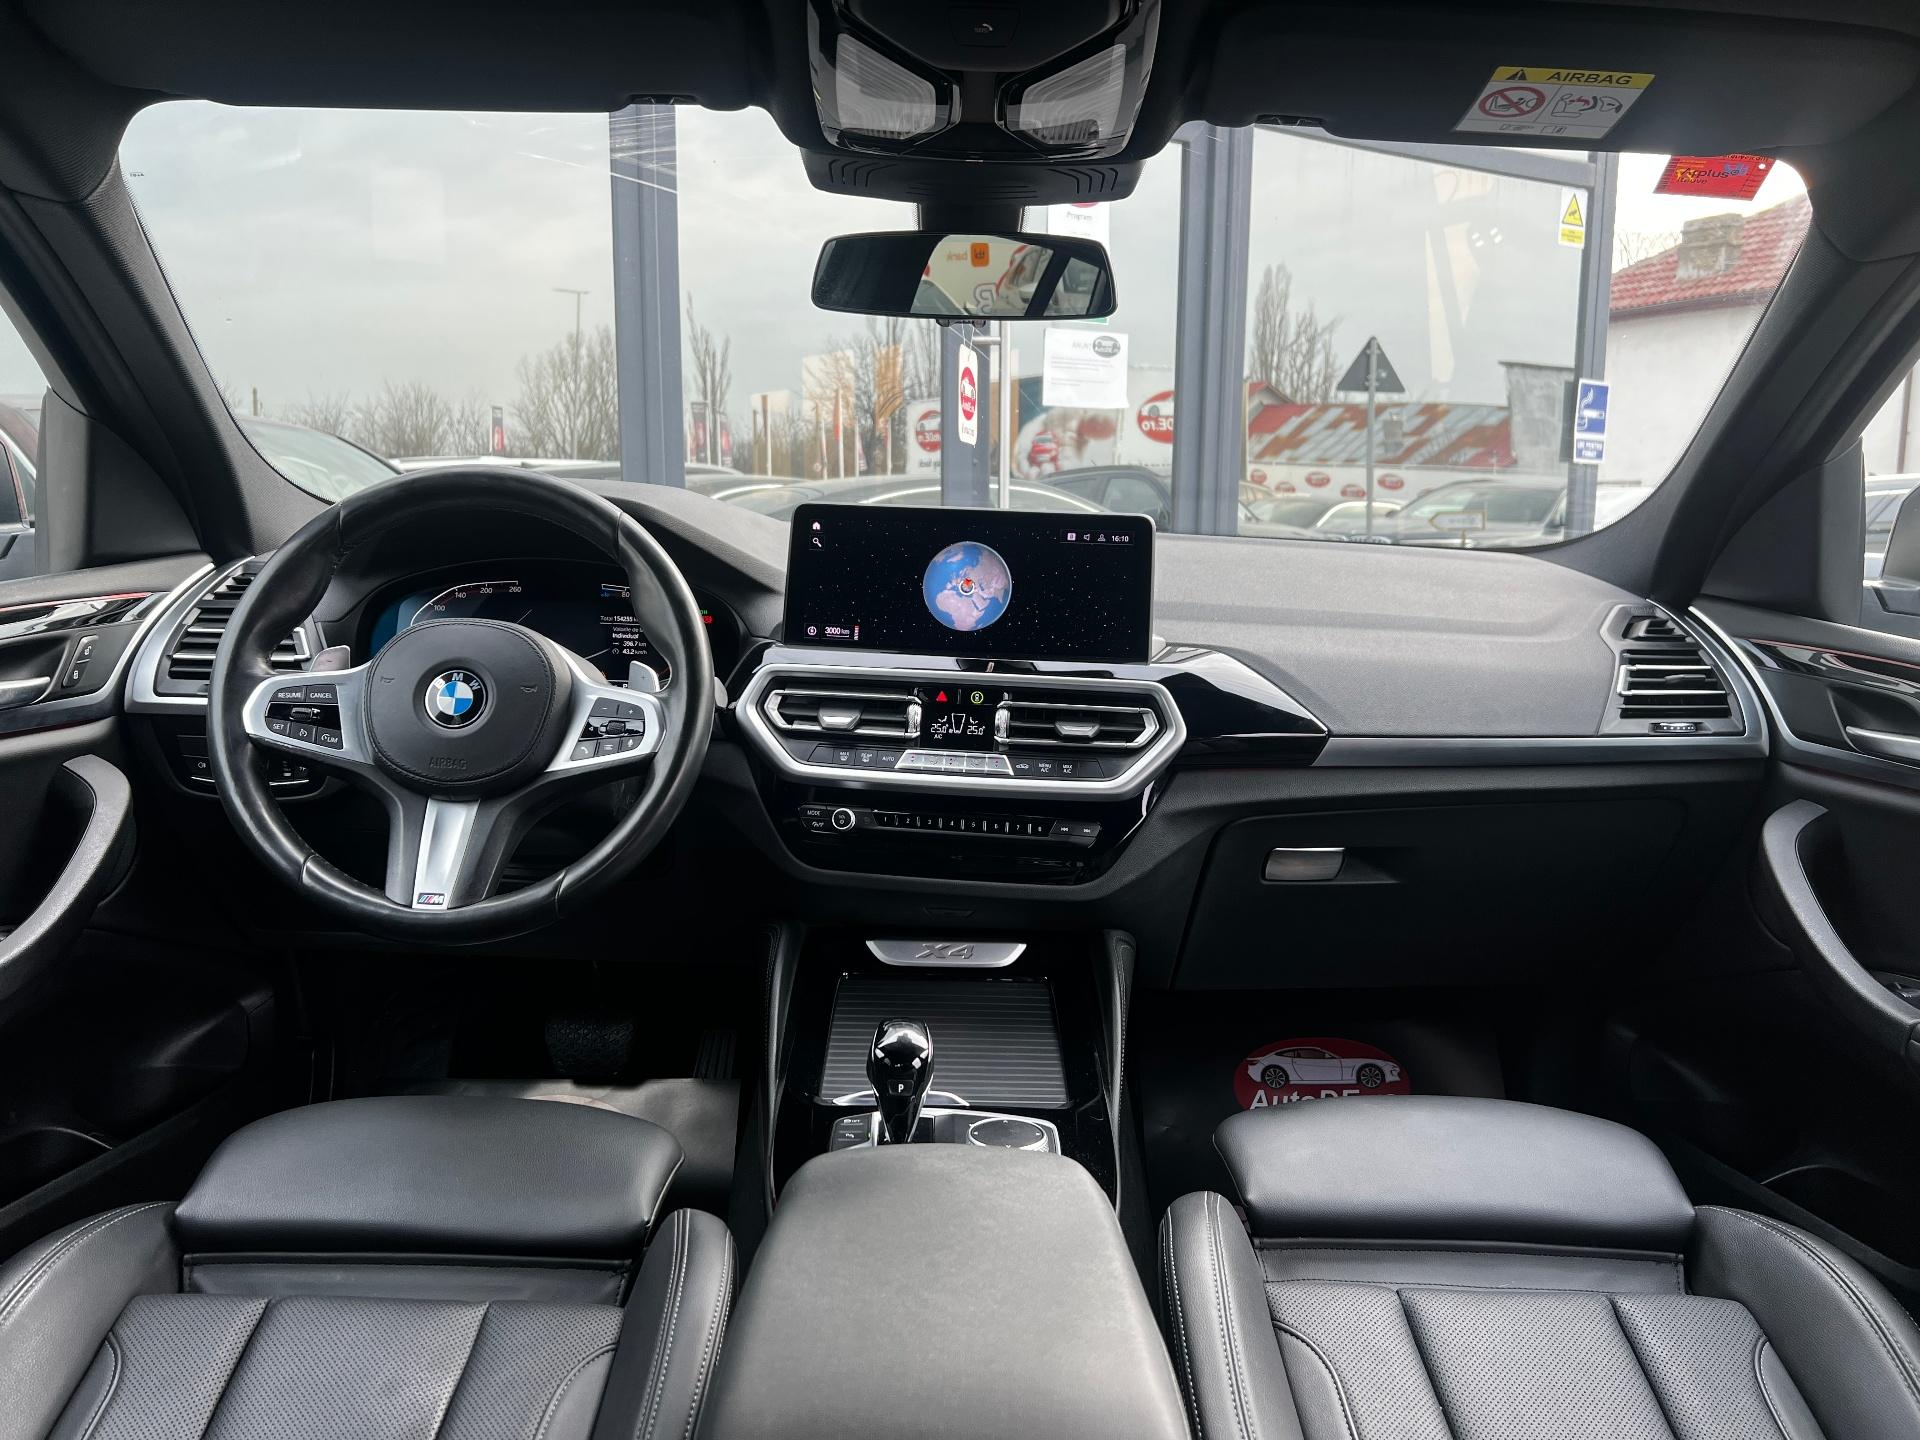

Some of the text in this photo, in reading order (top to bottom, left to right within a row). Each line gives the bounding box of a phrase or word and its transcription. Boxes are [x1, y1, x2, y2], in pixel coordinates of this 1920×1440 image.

[1547, 71, 1633, 86] AIRBAG
[1111, 535, 1129, 543] 16:10
[434, 604, 445, 612] 100
[824, 626, 841, 635] 3000
[433, 672, 481, 690] BMW
[326, 735, 339, 743] LIM
[429, 756, 468, 770] AIRBAG
[915, 943, 975, 960] X4
[898, 1083, 905, 1093] P
